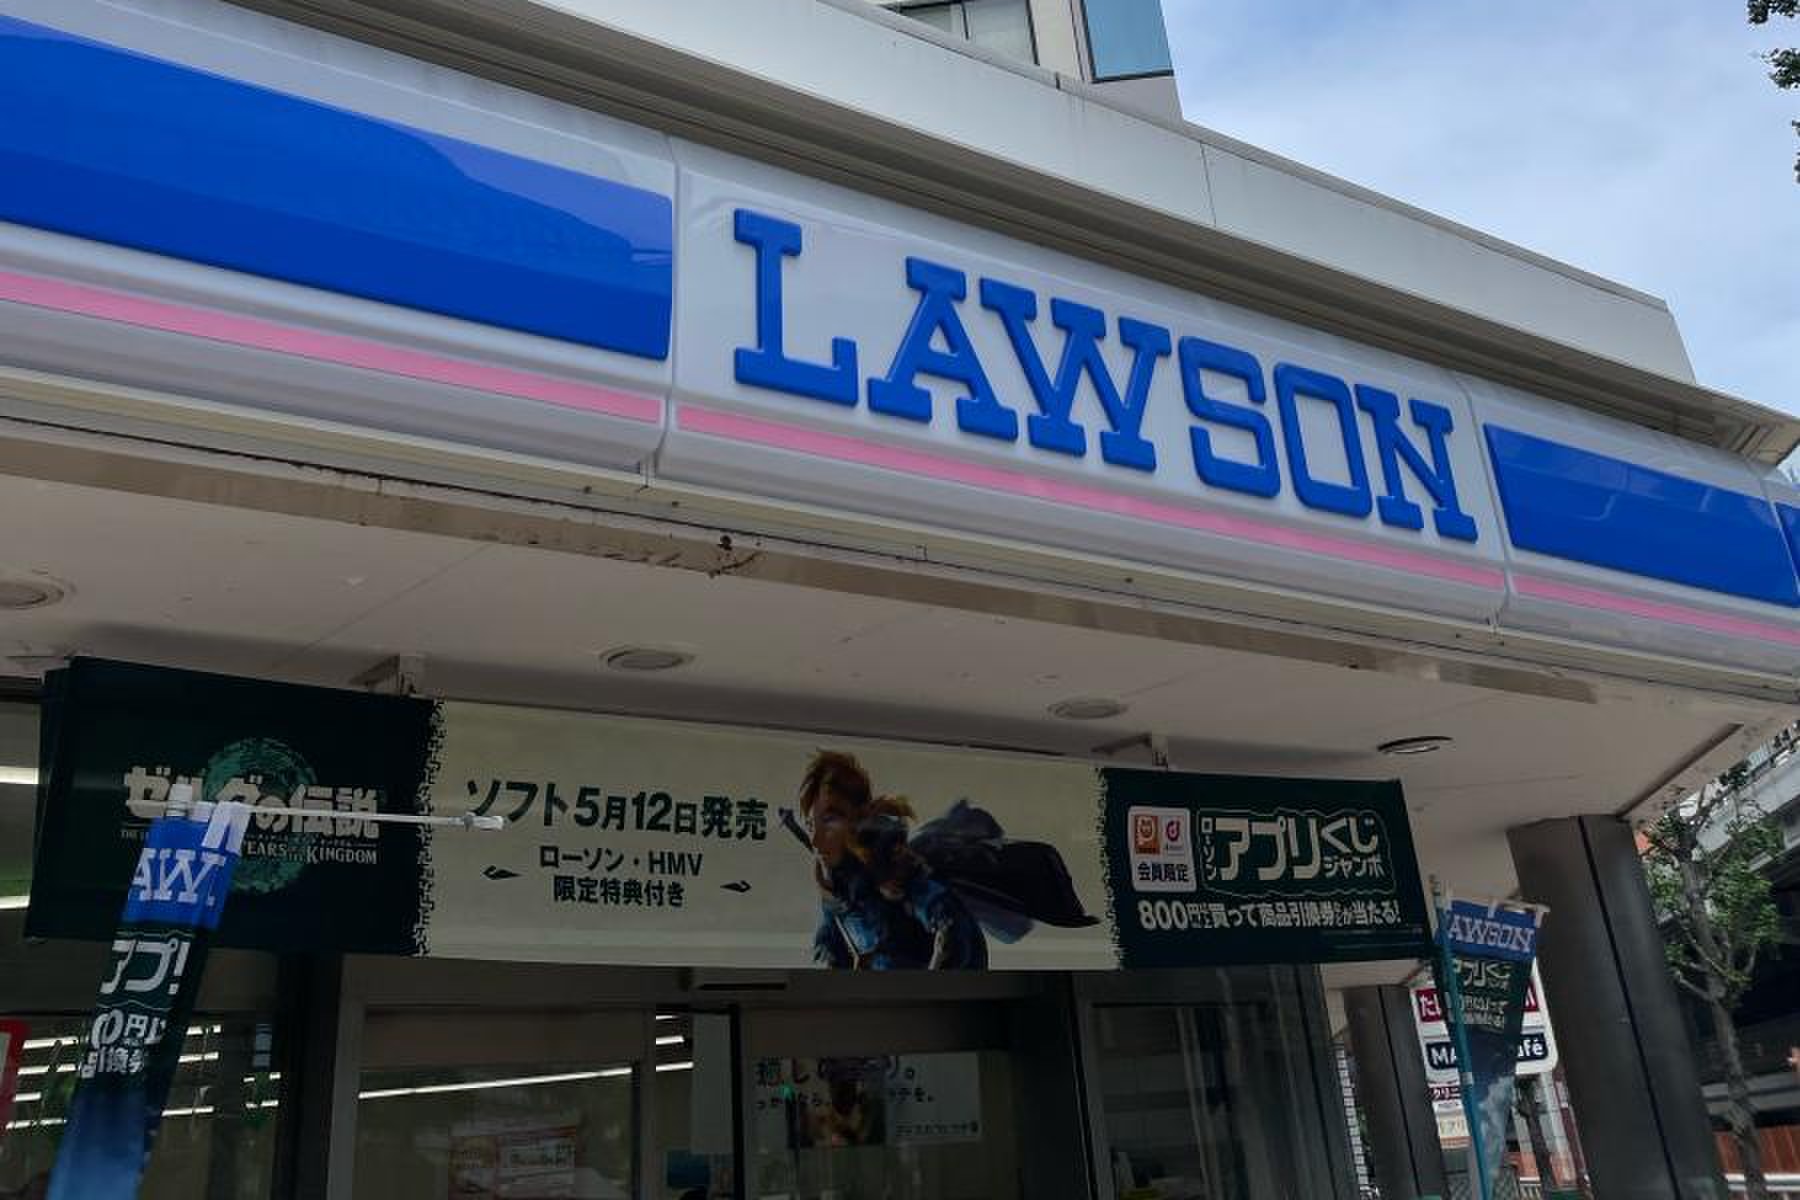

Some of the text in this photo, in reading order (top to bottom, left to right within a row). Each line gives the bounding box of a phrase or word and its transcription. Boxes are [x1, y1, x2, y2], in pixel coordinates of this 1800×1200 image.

[734, 208, 1478, 543] LAWSON
[467, 779, 768, 840] ソフト5月12日発売
[242, 840, 286, 857] EARS
[306, 845, 377, 865] KINGDOM
[1323, 856, 1386, 878] ジャンボ
[1138, 862, 1189, 883] 会員限定
[553, 876, 685, 907] 限定特典付き
[1448, 914, 1536, 953] AWSON
